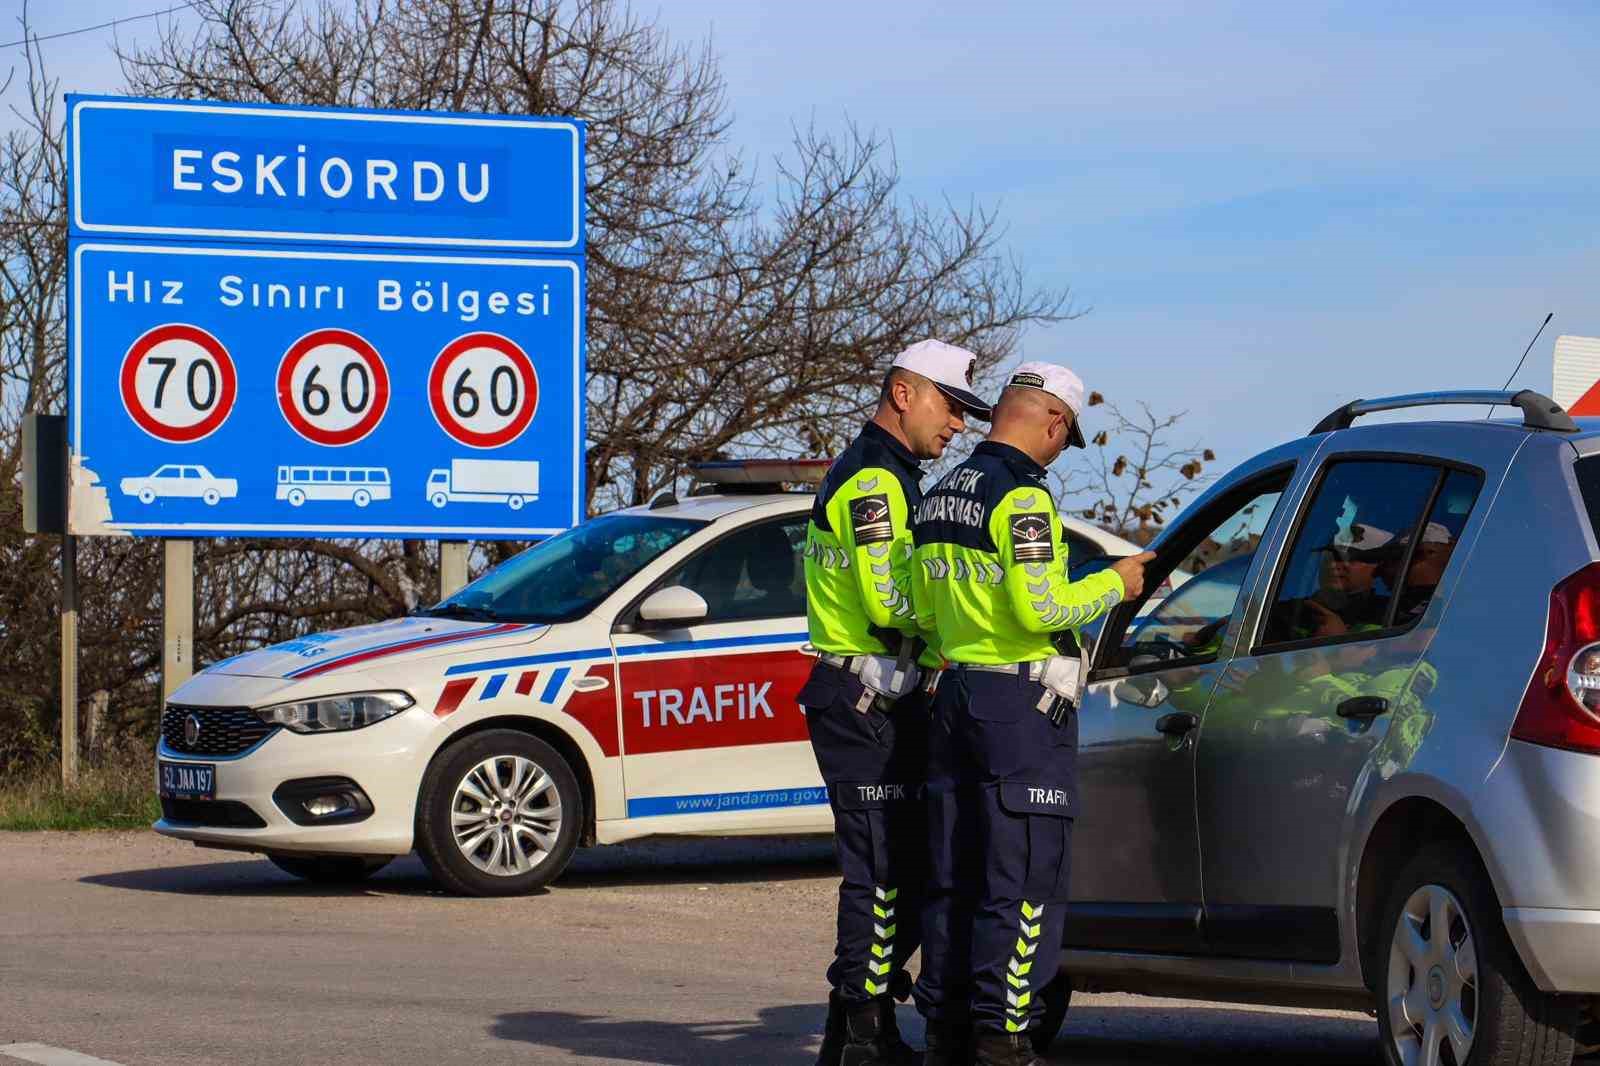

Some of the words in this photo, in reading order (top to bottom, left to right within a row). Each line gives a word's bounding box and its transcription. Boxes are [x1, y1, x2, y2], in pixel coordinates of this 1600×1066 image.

[173, 144, 490, 203] ESKİORDU
[108, 271, 184, 305] Hız
[378, 280, 550, 321] Bölgesi
[148, 358, 217, 411] 70
[302, 363, 370, 416] 60
[453, 366, 518, 418] 60
